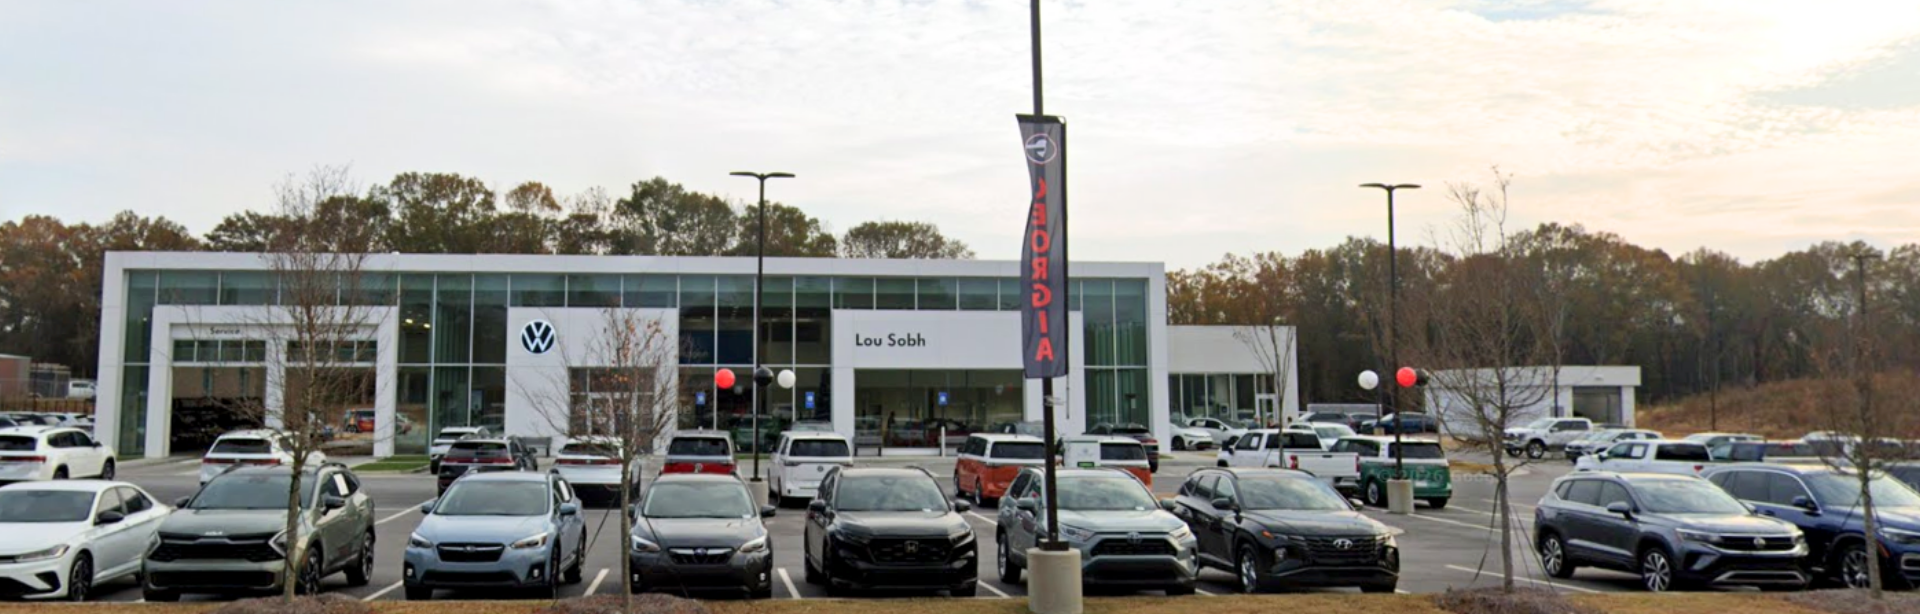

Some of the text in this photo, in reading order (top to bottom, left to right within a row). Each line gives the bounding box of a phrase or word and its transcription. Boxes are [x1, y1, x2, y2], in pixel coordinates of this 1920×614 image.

[210, 326, 240, 335] Service
[855, 332, 926, 347] Lou Sobh
